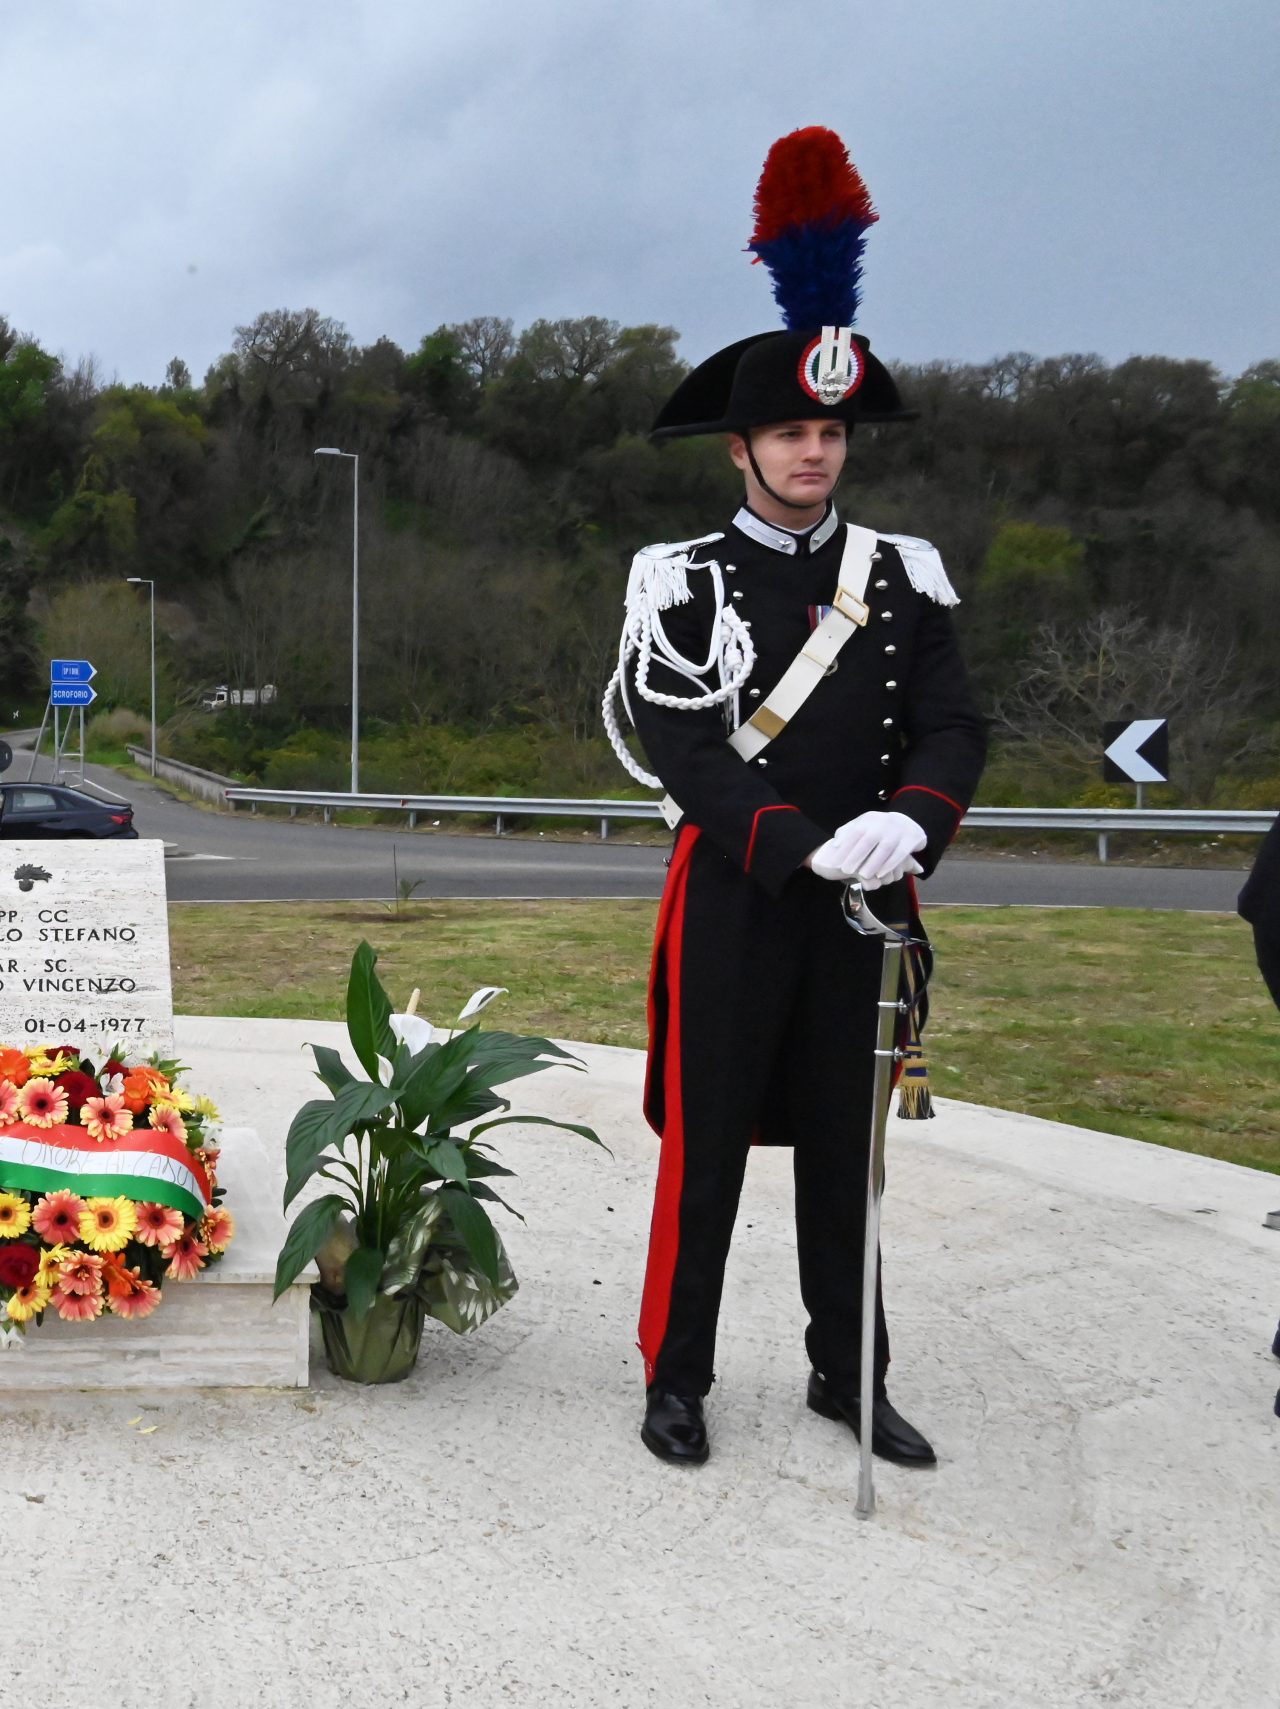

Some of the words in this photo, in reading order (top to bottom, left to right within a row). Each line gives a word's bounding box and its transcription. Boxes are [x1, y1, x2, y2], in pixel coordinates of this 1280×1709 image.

[53, 690, 88, 698] SCROFORIO
[38, 909, 68, 923] CC
[38, 928, 136, 942] STEFANO
[22, 978, 136, 993] VINCENZO
[24, 1018, 146, 1034] 01-04-1977
